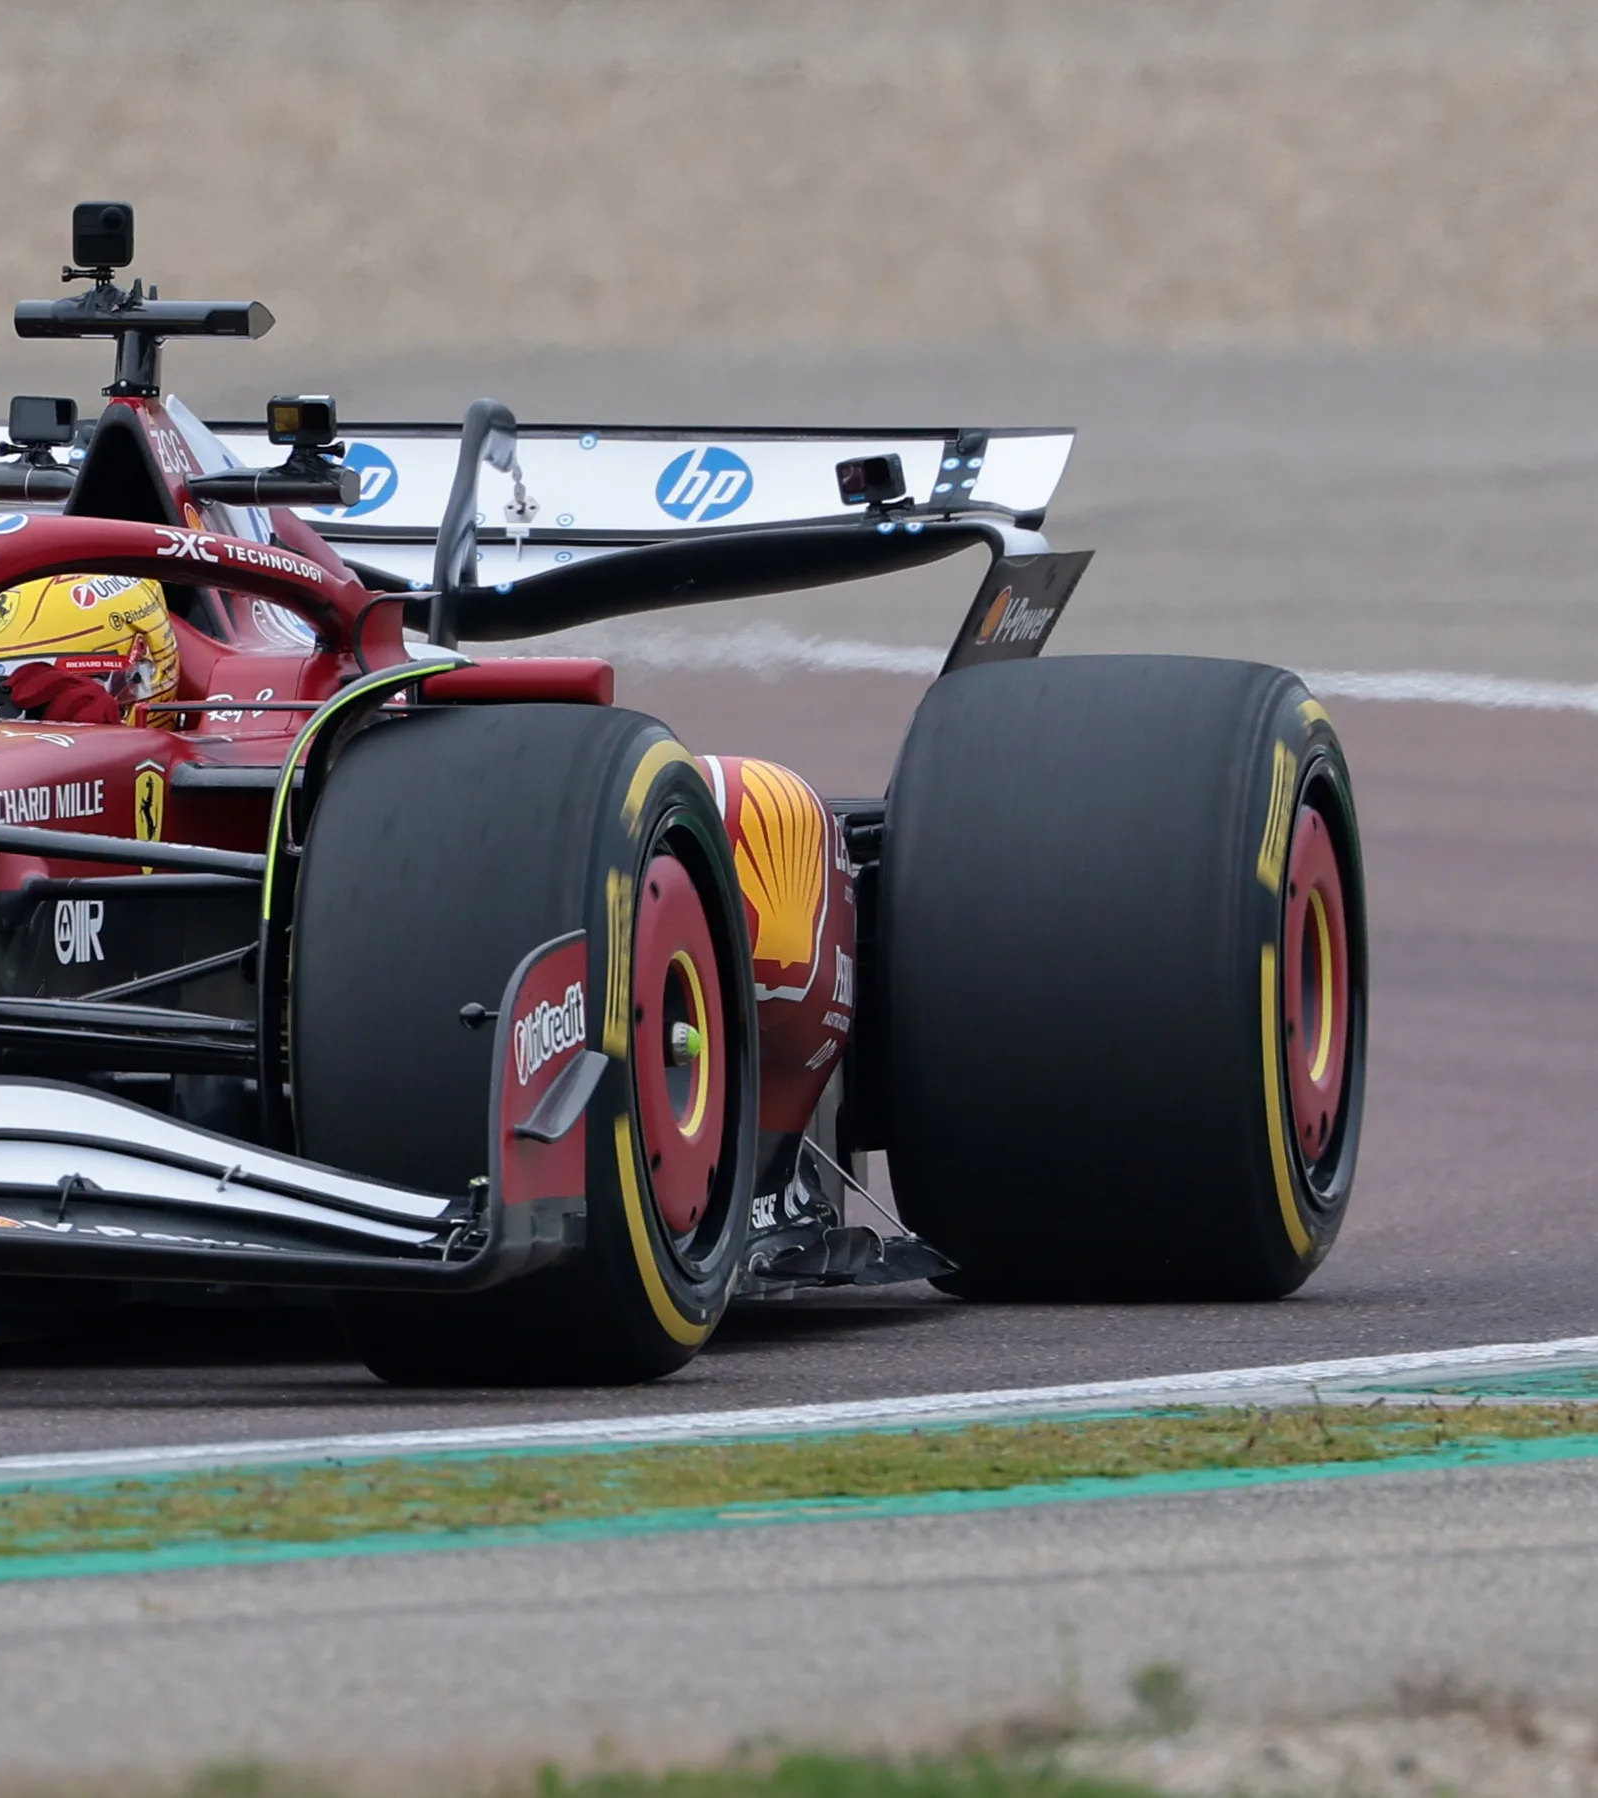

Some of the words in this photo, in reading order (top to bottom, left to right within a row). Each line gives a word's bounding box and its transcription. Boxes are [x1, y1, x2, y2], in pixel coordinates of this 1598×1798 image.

[662, 447, 748, 522] hp
[154, 529, 219, 564] DXC
[223, 544, 324, 584] TECHNOLOGY
[55, 780, 104, 819] MILLE
[525, 981, 586, 1075] UniCredit
[751, 1192, 777, 1230] SKF
